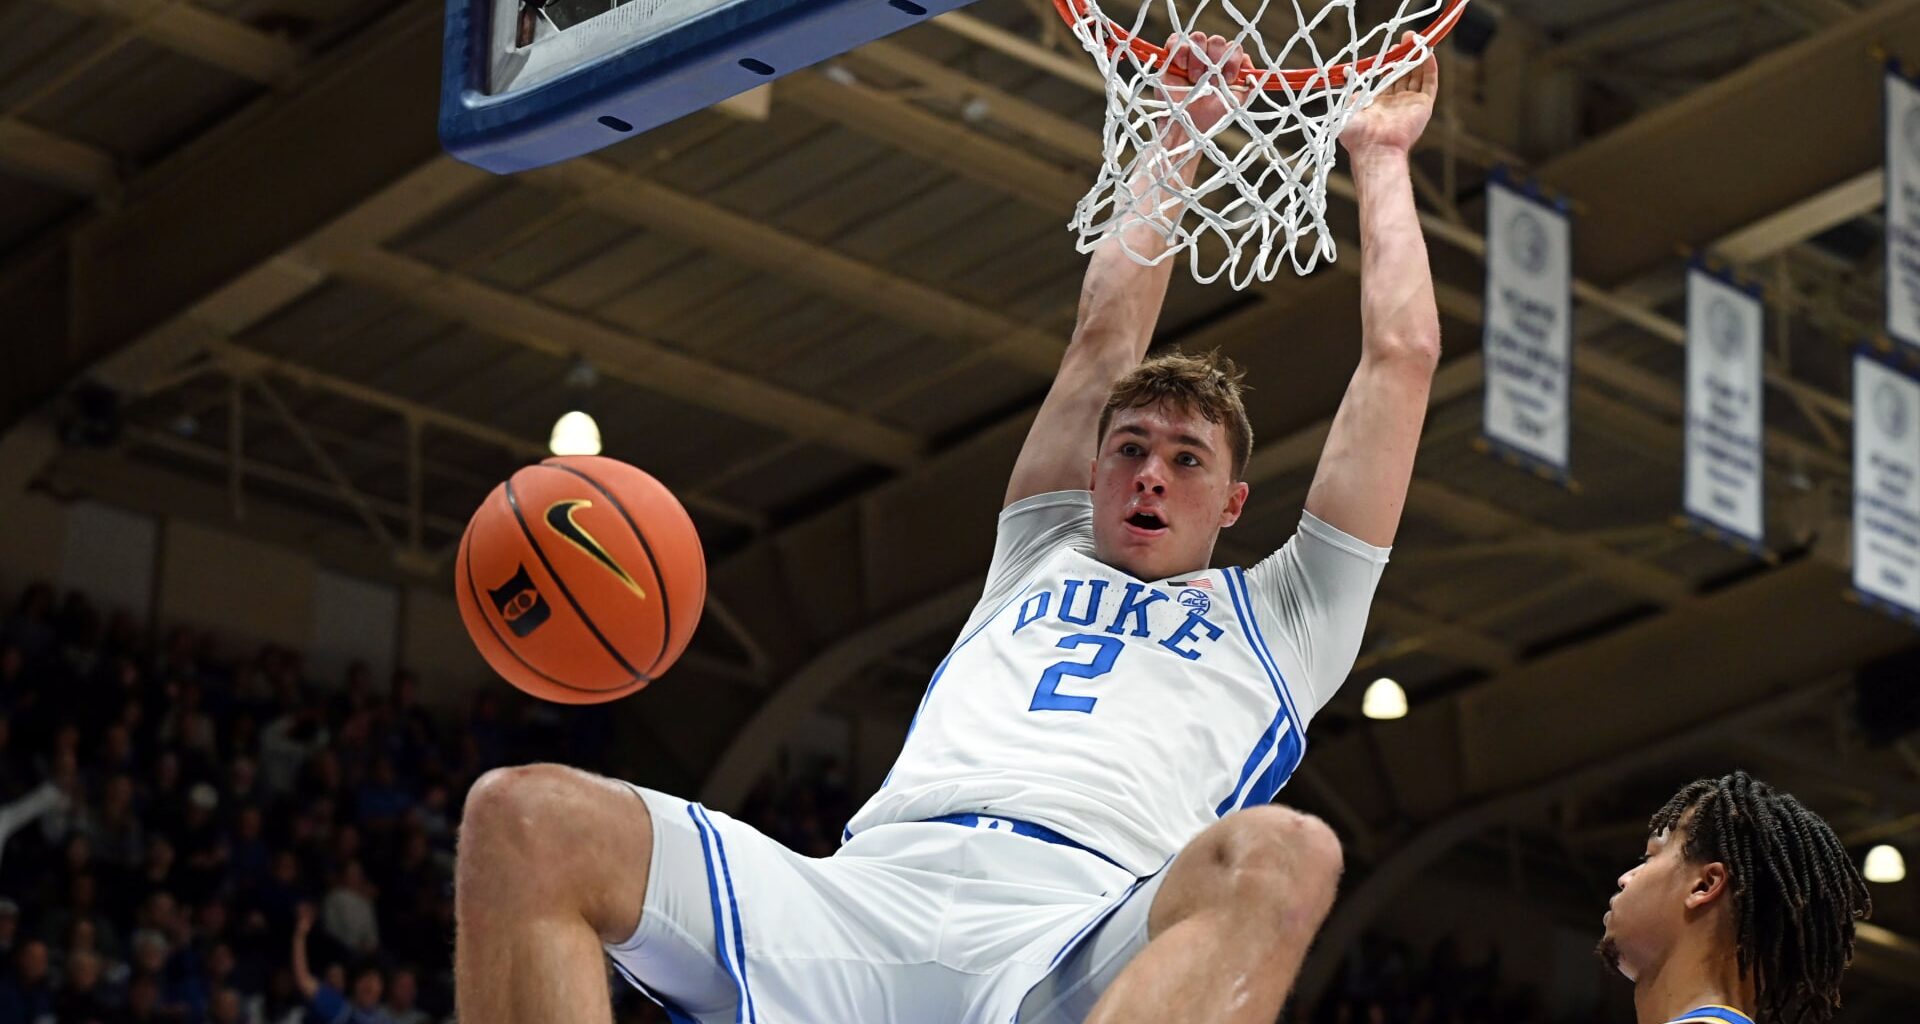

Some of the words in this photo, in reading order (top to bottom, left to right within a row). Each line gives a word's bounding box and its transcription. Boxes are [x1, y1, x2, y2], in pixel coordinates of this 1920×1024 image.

[1012, 579, 1225, 661] DUKE
[1181, 597, 1208, 607] ACC
[1028, 633, 1126, 714] 2
